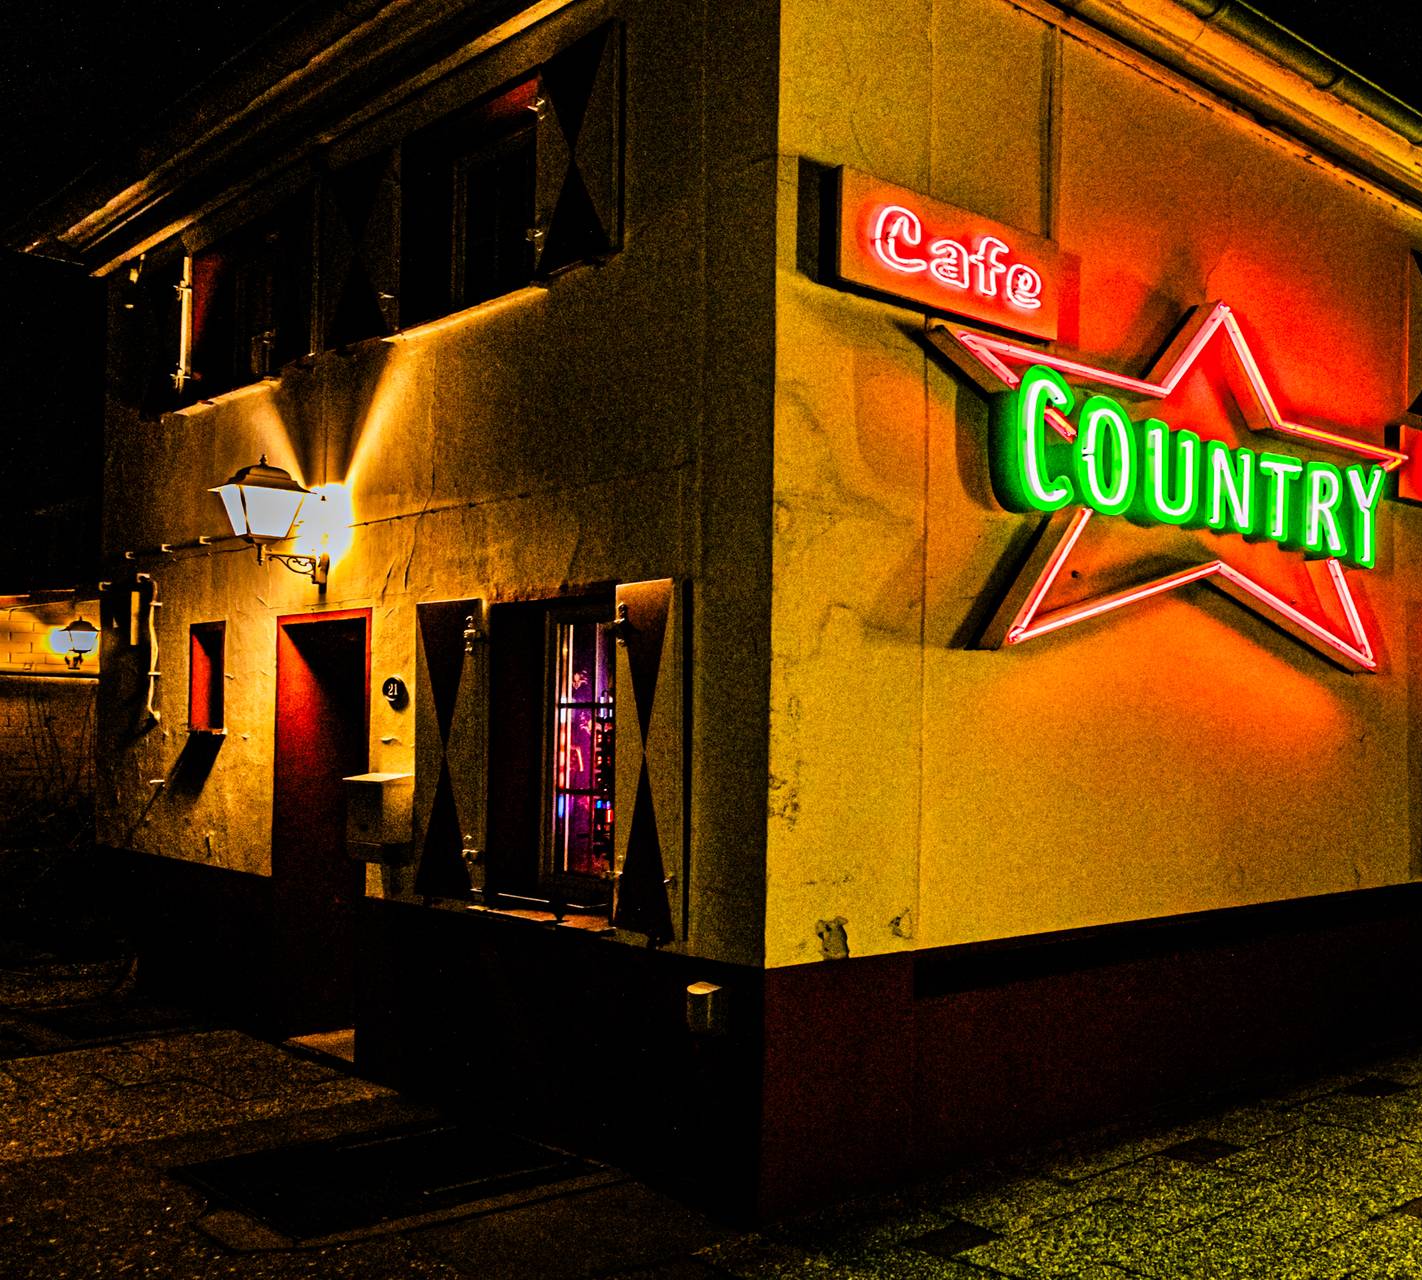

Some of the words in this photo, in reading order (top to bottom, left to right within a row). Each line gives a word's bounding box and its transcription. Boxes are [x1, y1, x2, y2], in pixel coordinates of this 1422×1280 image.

[874, 205, 1042, 309] Cafe
[1017, 364, 1382, 569] COUNTRY
[387, 683, 398, 696] 21
